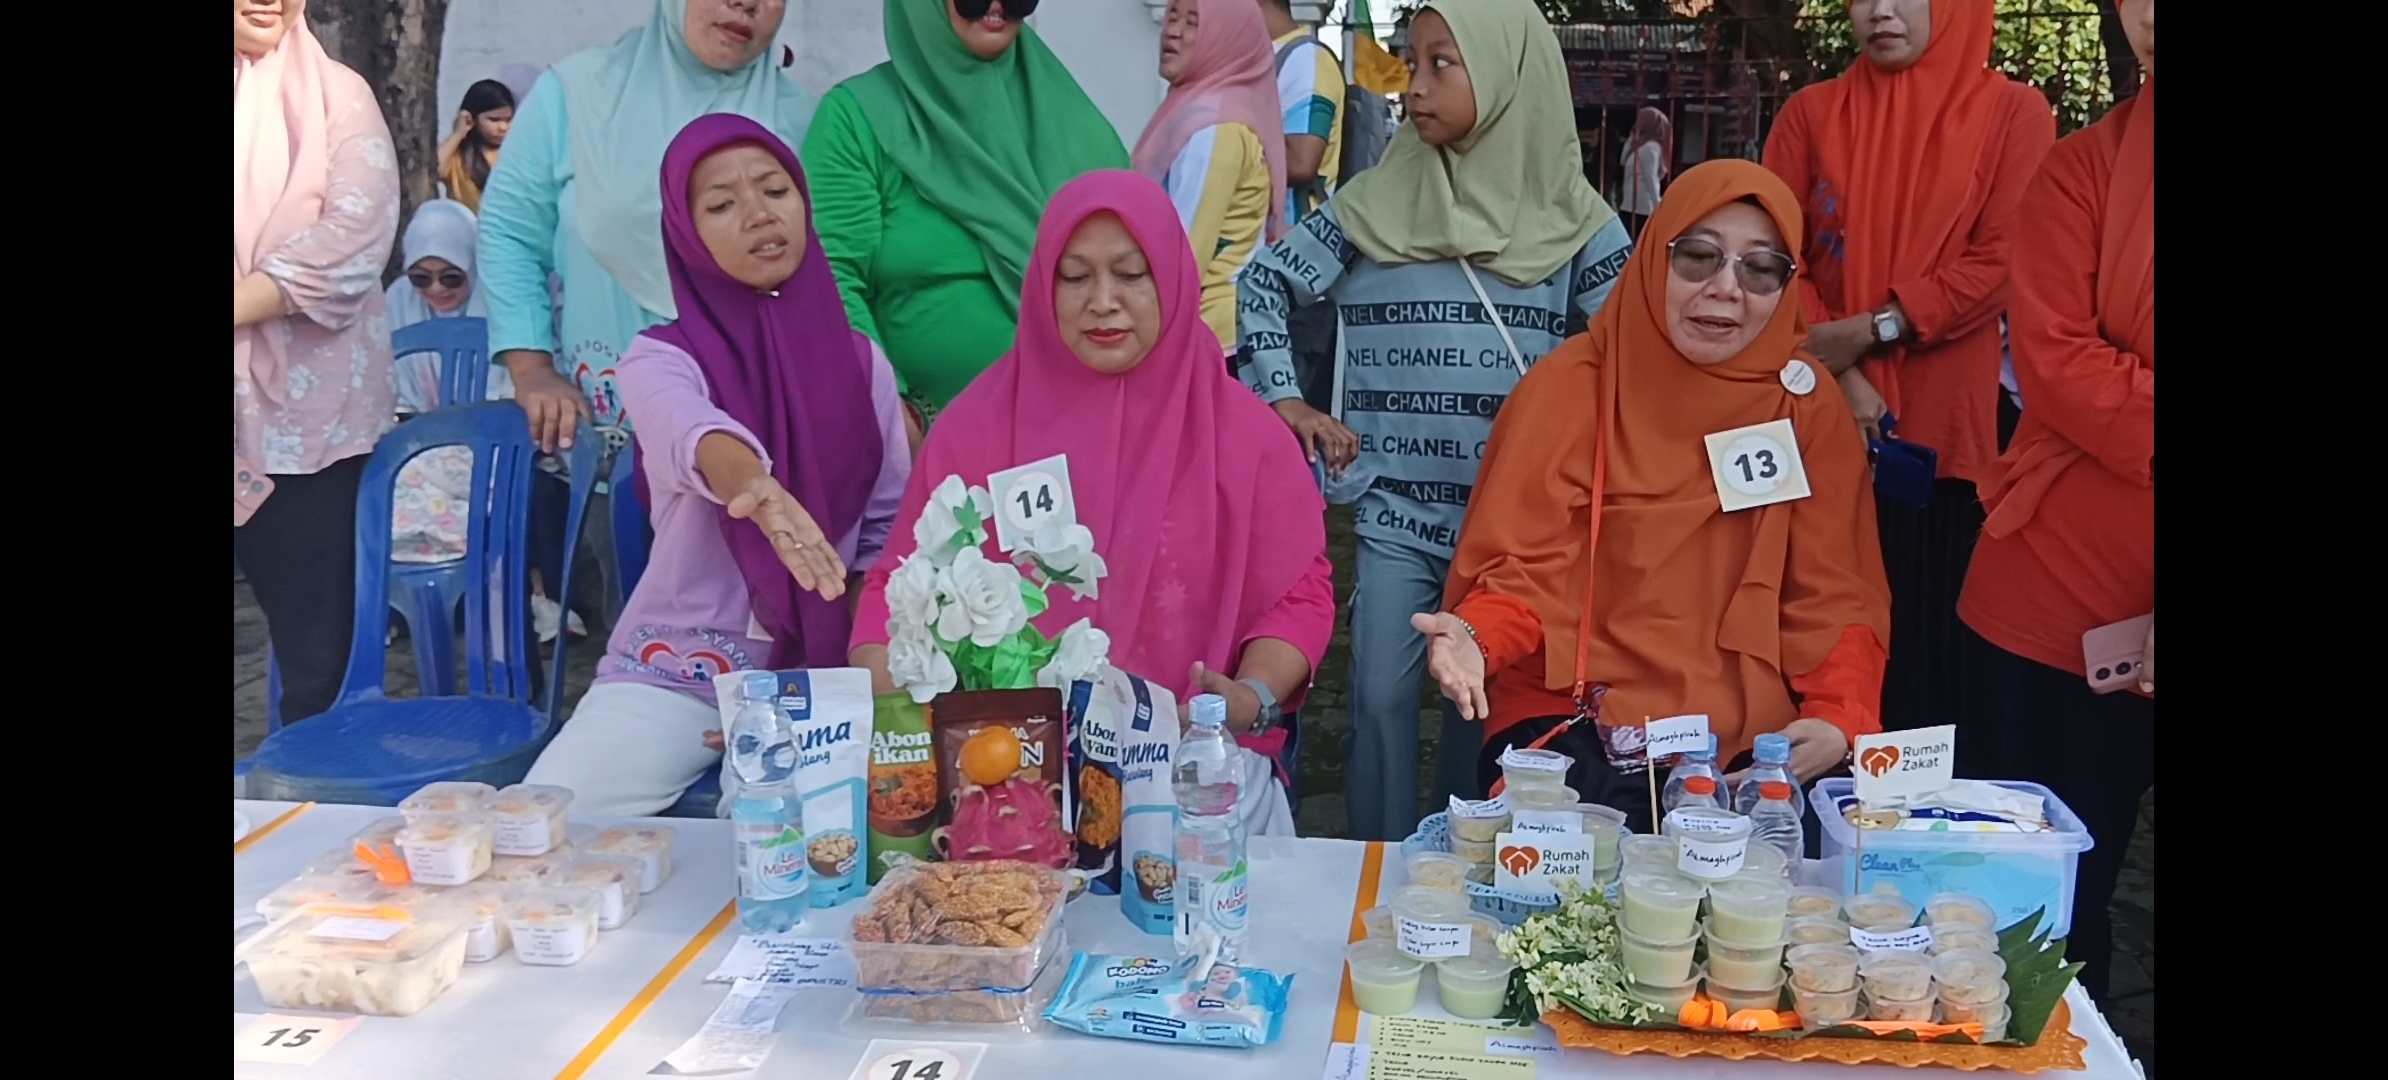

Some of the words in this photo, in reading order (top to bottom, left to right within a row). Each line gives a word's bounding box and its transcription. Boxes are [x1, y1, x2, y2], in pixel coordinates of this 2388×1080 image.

[1385, 303, 1475, 323] CHANEL
[1347, 349, 1382, 367] NEL
[1387, 348, 1472, 368] CHANEL
[1348, 392, 1379, 410] NEL
[1386, 393, 1470, 414] CHANEL
[1382, 435, 1468, 460] CHANEL
[1734, 449, 1778, 482] 13
[1015, 484, 1054, 519] 14
[1377, 509, 1457, 548] CHANEL
[870, 730, 932, 747] Abon
[874, 747, 930, 765] ikan
[1902, 743, 1949, 758] Rumah
[1902, 757, 1939, 772] Zakat
[1543, 849, 1590, 861] Rumah
[1860, 853, 1898, 871] Clean
[1543, 863, 1580, 875] Zakat
[1108, 965, 1169, 977] KODOMO
[261, 1028, 322, 1048] 15
[890, 1059, 944, 1080] 14
